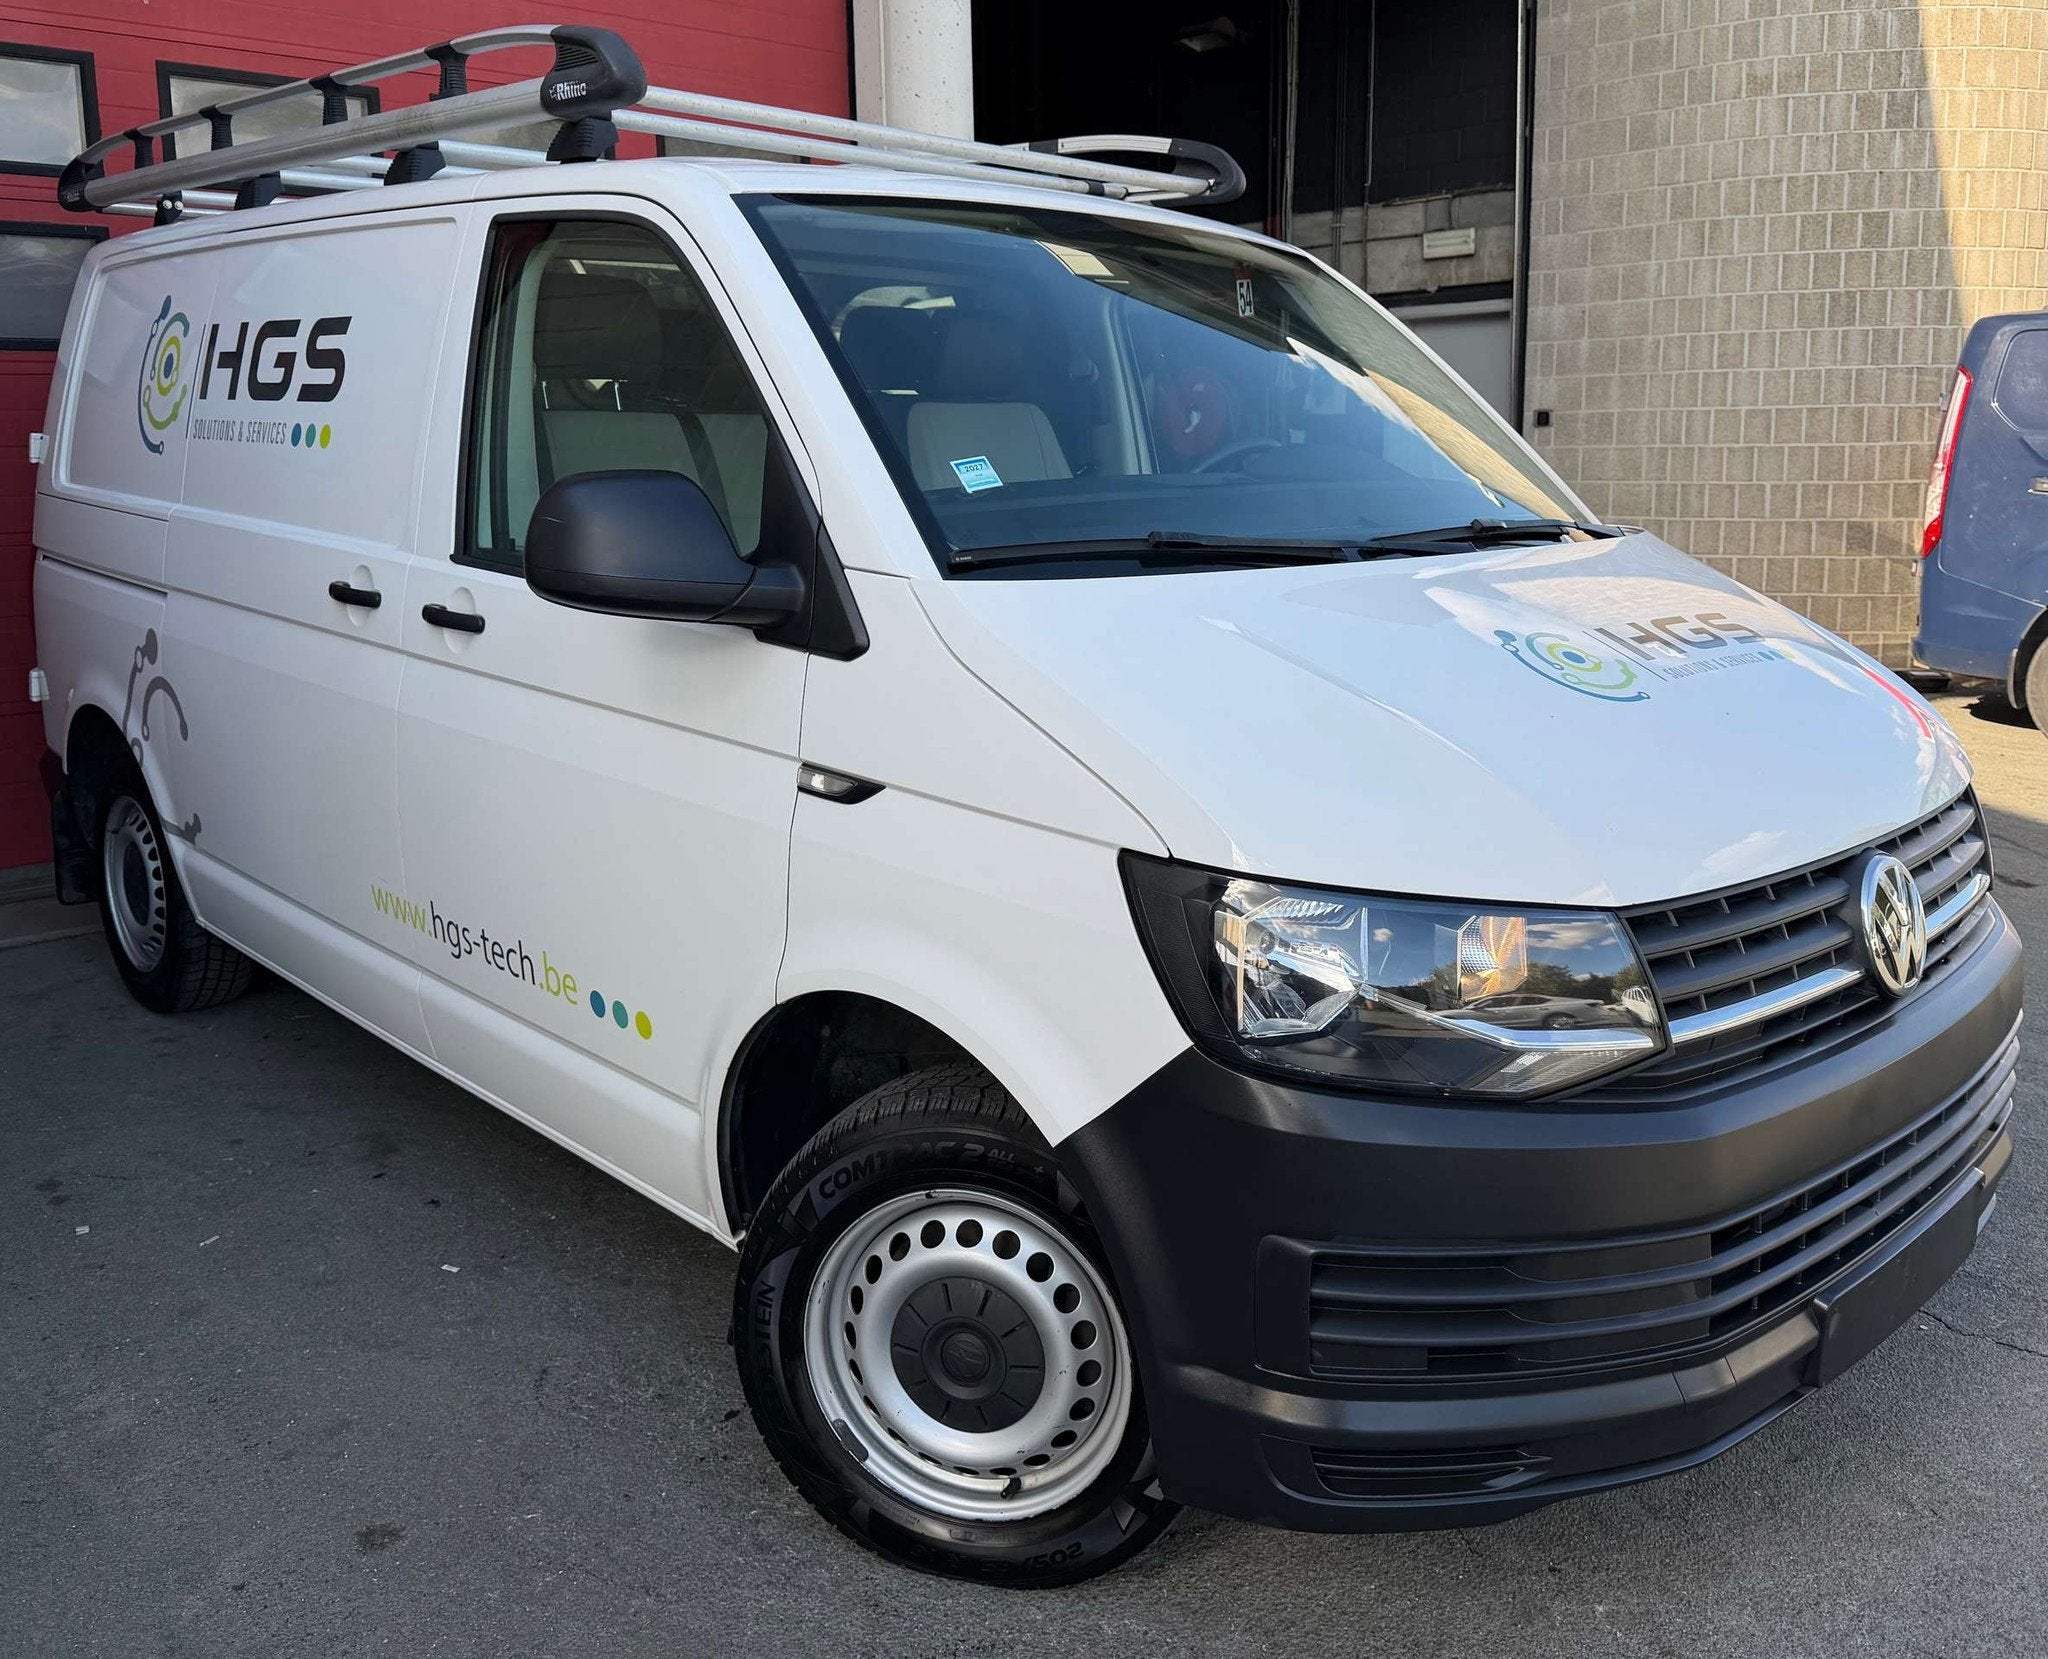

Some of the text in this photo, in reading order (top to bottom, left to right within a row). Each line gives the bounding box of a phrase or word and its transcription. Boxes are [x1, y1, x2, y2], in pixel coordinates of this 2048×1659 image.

[556, 82, 587, 101] Rhino
[1238, 280, 1253, 315] 54
[199, 316, 352, 402] HGS
[193, 418, 287, 445] SOLUTIONS & SERVICES
[964, 463, 983, 473] 2027
[1594, 613, 1765, 660] HGS
[371, 884, 578, 1005] www.hgs-tech.be
[987, 1148, 1016, 1164] ALL
